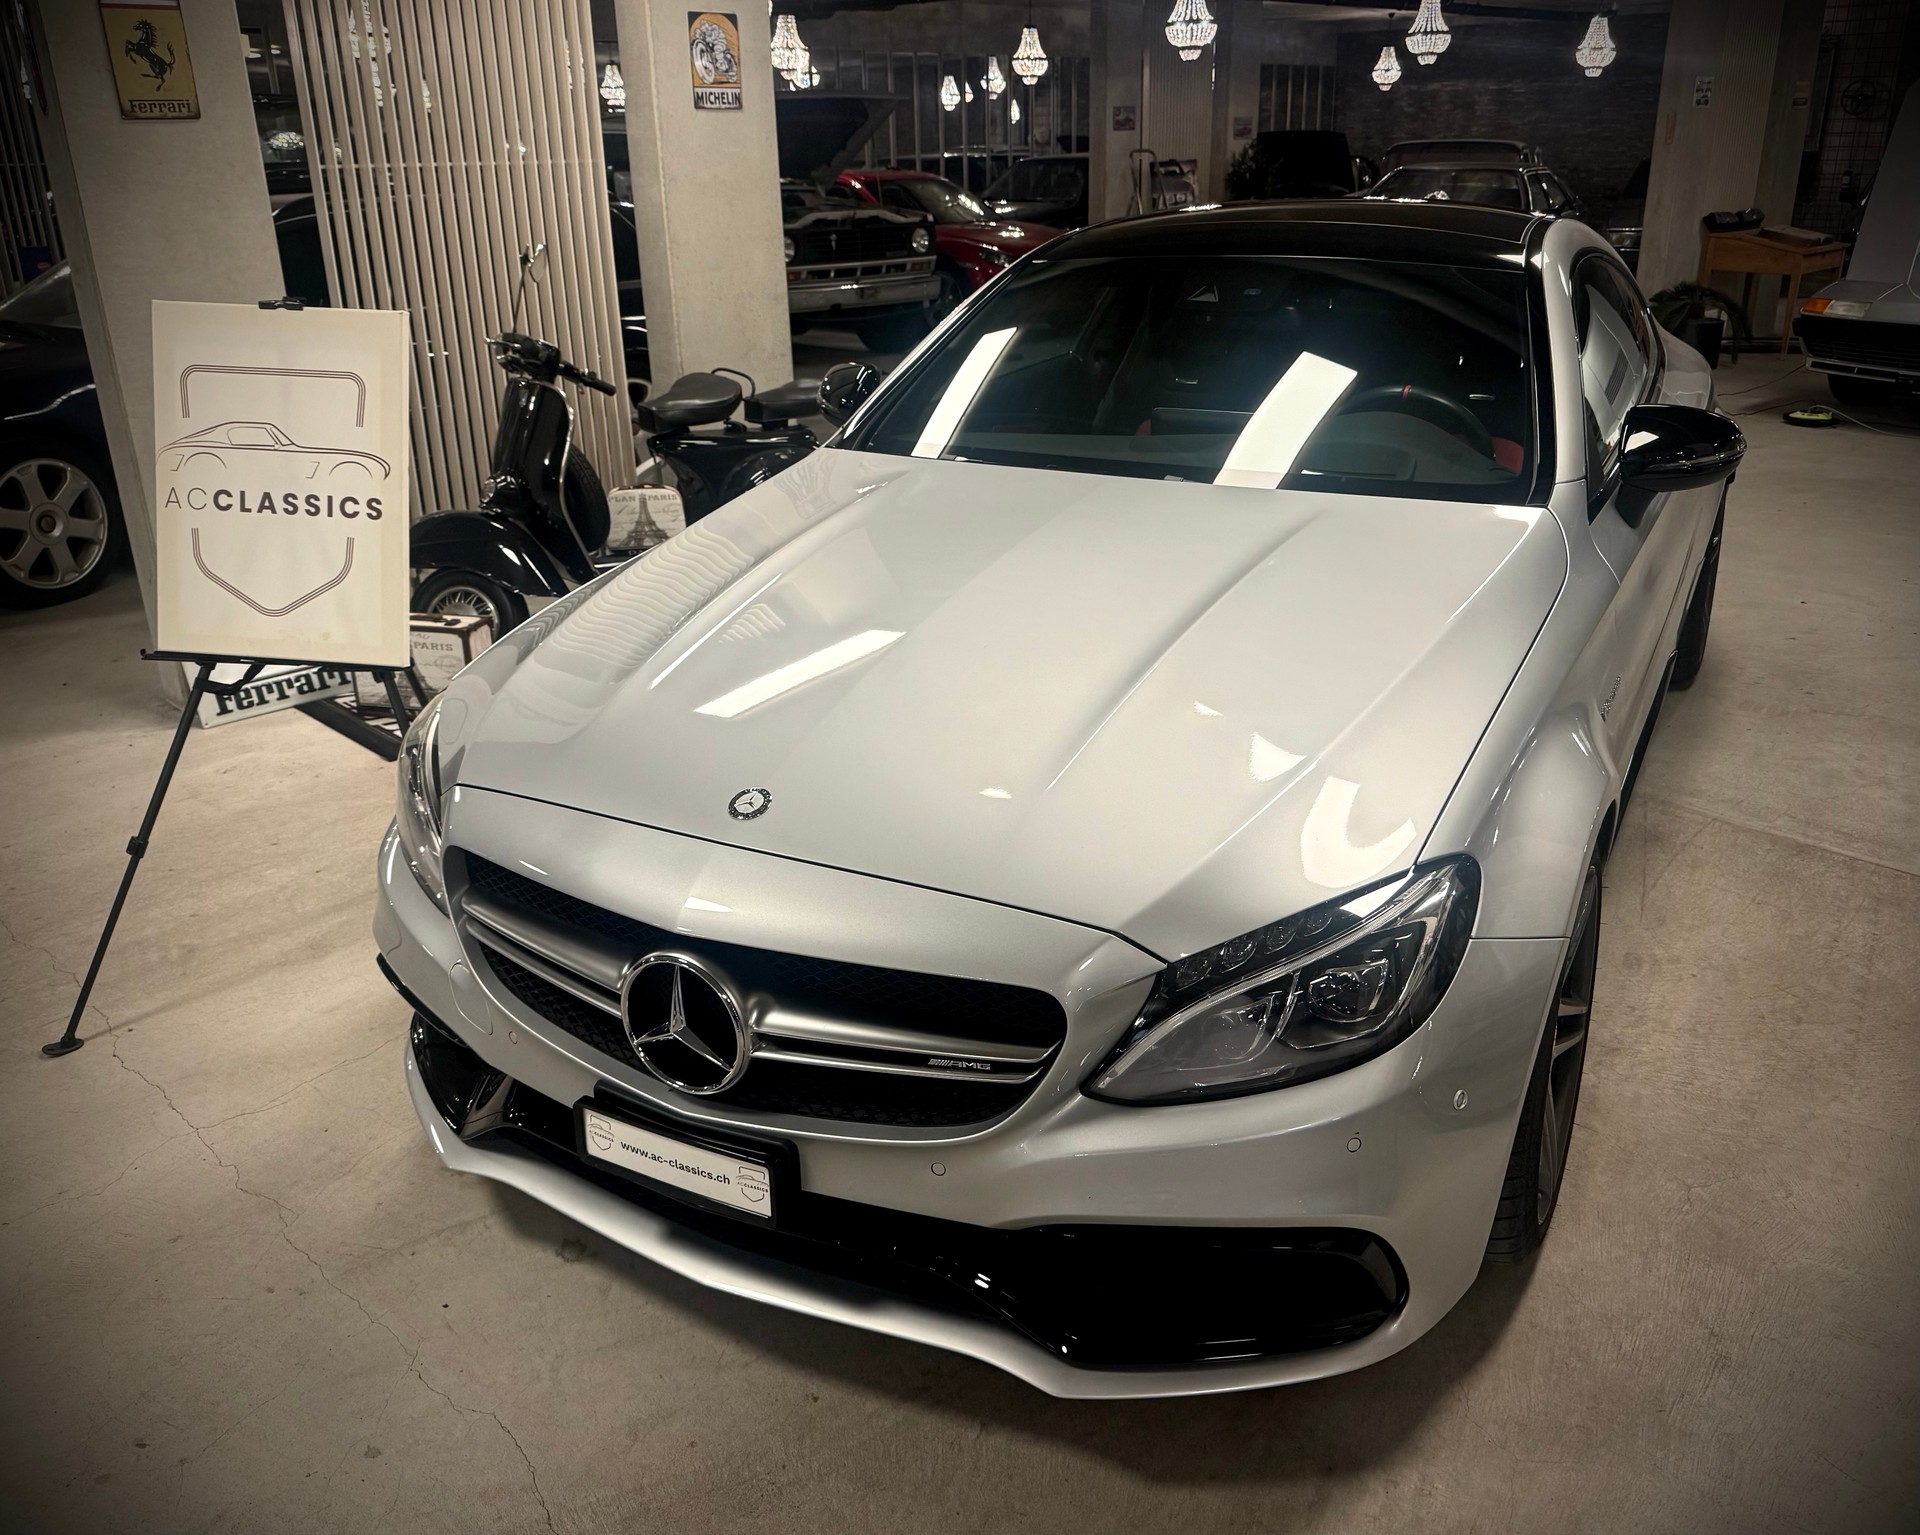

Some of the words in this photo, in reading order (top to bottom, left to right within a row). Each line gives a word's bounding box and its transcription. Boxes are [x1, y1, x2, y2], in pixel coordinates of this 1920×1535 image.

[696, 91, 741, 105] MICHELIN
[128, 99, 192, 113] Ferrari
[647, 494, 678, 502] PARIS
[414, 641, 454, 651] PARIS
[946, 1060, 991, 1071] AMG
[620, 1141, 731, 1185] www.ac-classics.ch
